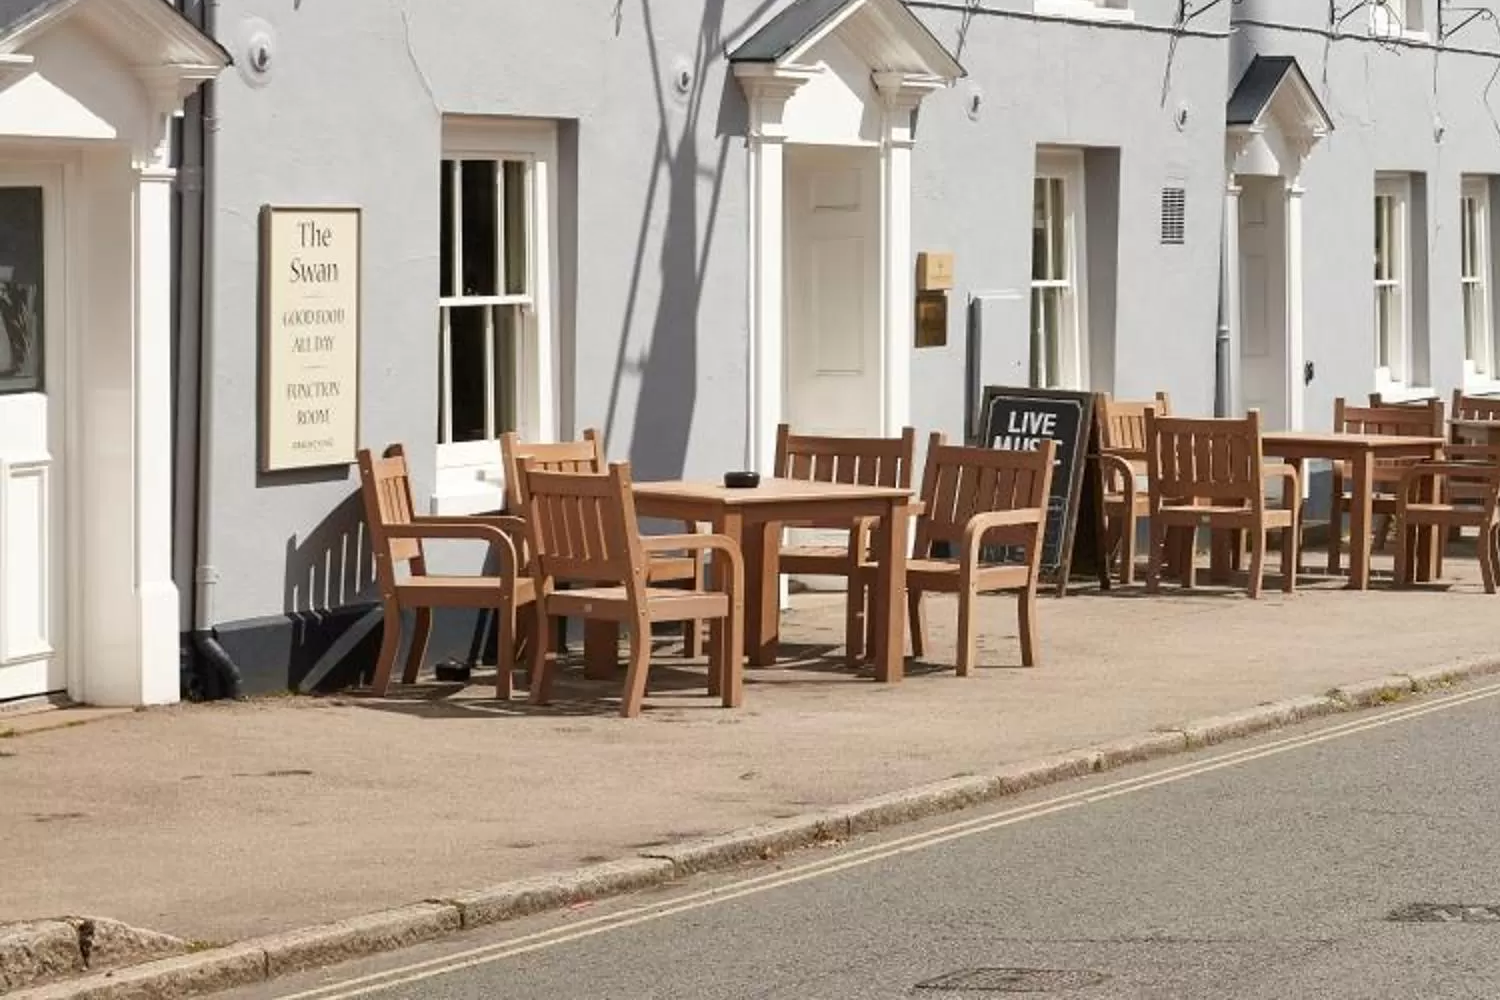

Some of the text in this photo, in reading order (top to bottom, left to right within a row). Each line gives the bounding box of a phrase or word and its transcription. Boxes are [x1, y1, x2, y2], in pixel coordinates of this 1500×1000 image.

[297, 220, 332, 248] The
[289, 257, 339, 284] Swan
[283, 308, 345, 328] GOOD FOOD
[292, 335, 335, 353] ALL DAY
[287, 381, 341, 400] FUNCTION
[297, 408, 331, 425] ROOM
[1007, 411, 1057, 435] LIVE
